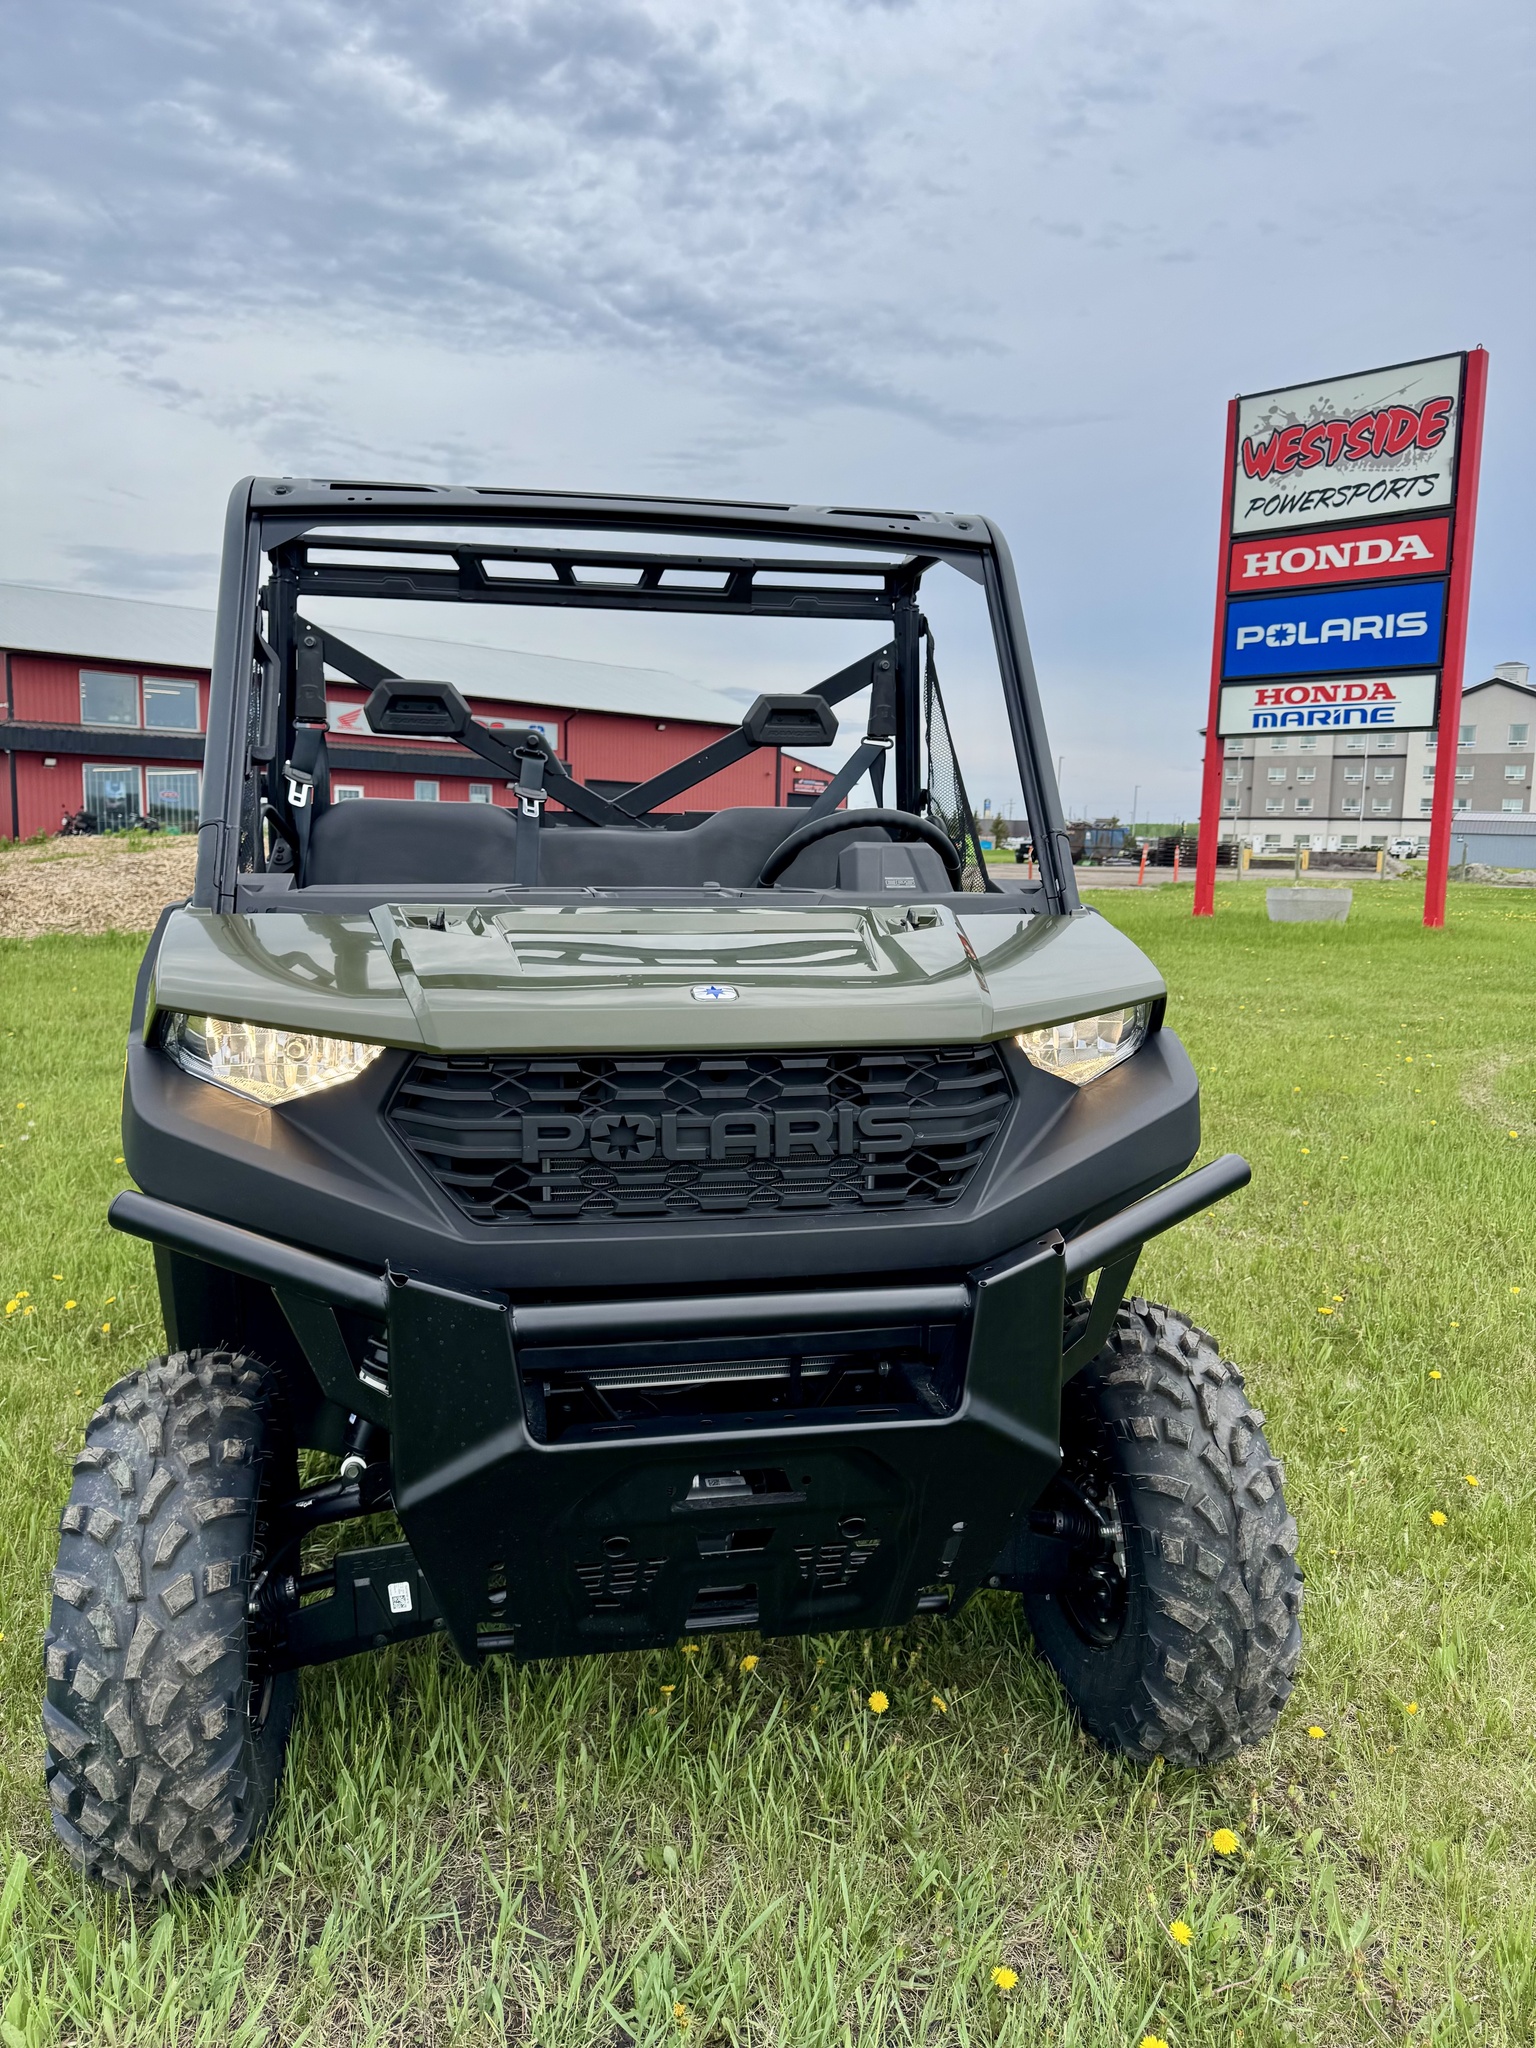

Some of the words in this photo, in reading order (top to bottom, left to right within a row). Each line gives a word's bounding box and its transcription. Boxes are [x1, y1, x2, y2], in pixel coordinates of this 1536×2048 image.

[1242, 396, 1455, 481] WESTSIDE
[1244, 473, 1440, 519] POWERSPORTS
[1242, 535, 1434, 578] HONDA
[1236, 611, 1427, 650] POLARIS
[1254, 682, 1396, 706] HONDA
[1252, 706, 1396, 729] MARINE
[522, 1102, 915, 1163] POLARIS
